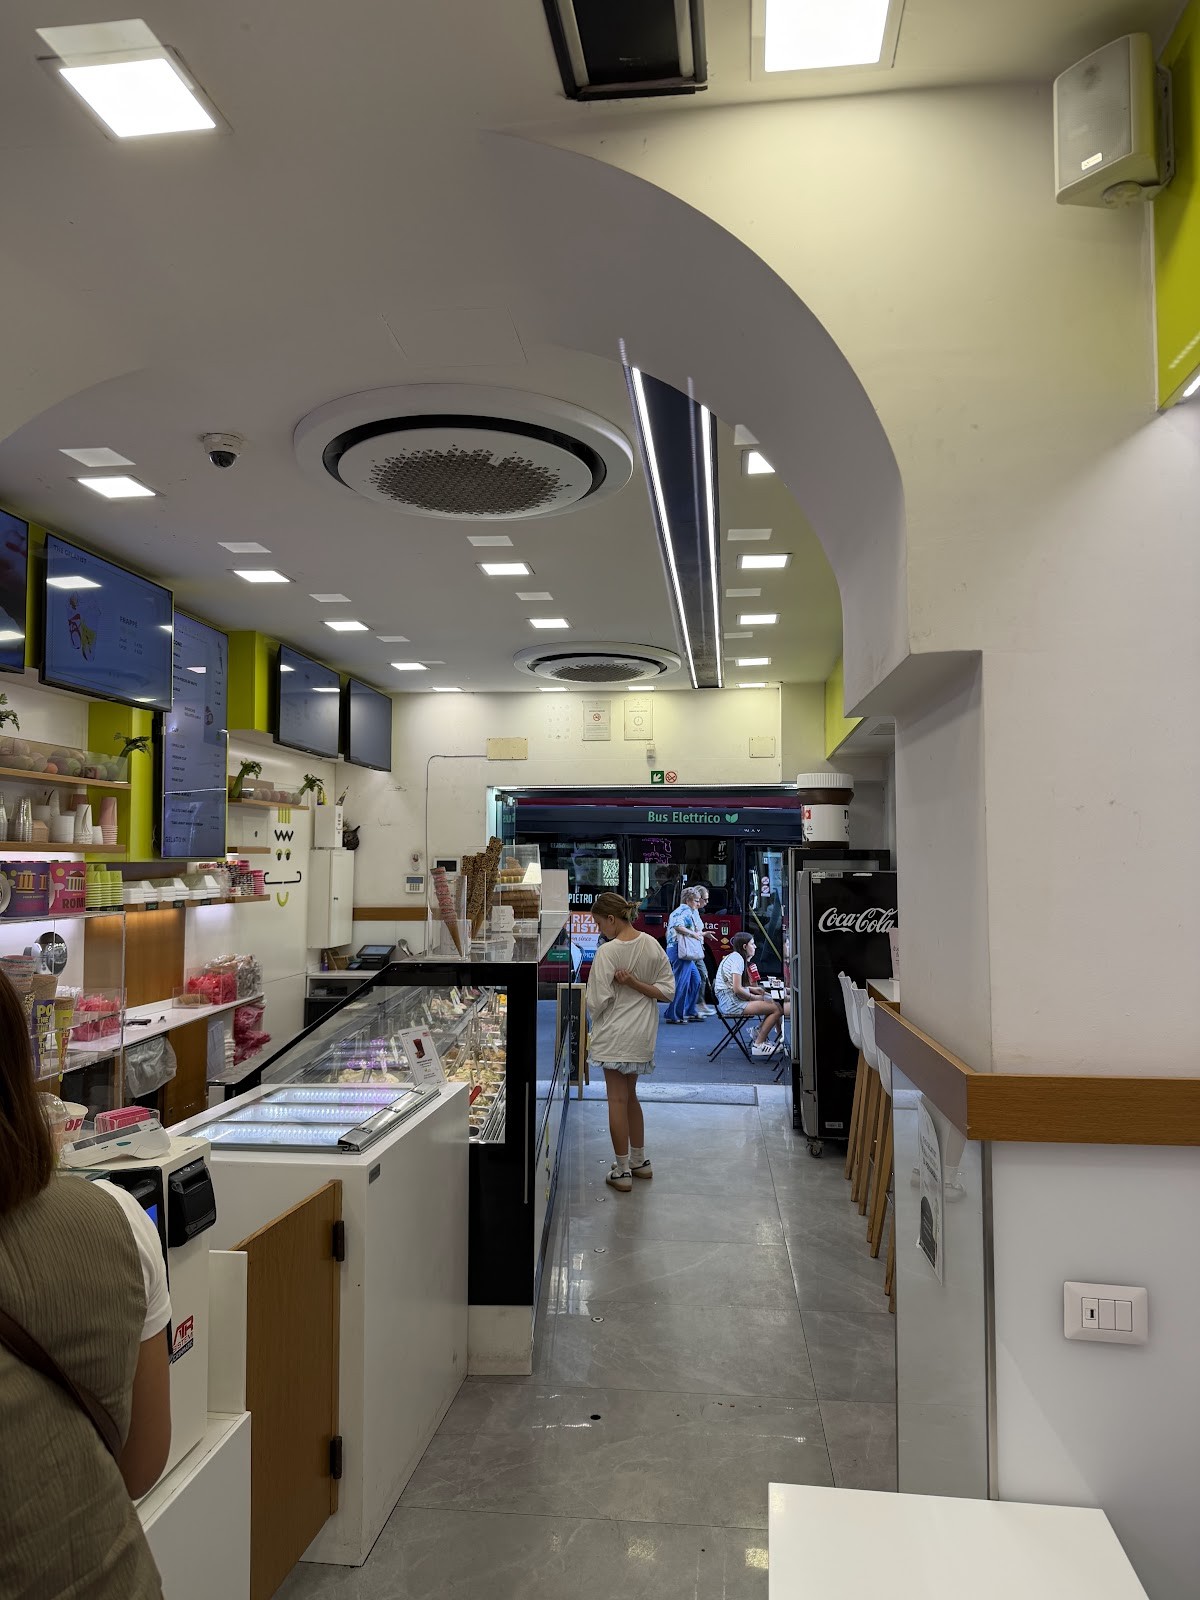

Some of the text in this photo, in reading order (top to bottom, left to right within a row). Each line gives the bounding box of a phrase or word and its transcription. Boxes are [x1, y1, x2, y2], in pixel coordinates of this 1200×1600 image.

[648, 811, 721, 824] Bus Elettrico
[568, 893, 593, 904] PIETRO
[818, 907, 898, 934] Coca-Cola
